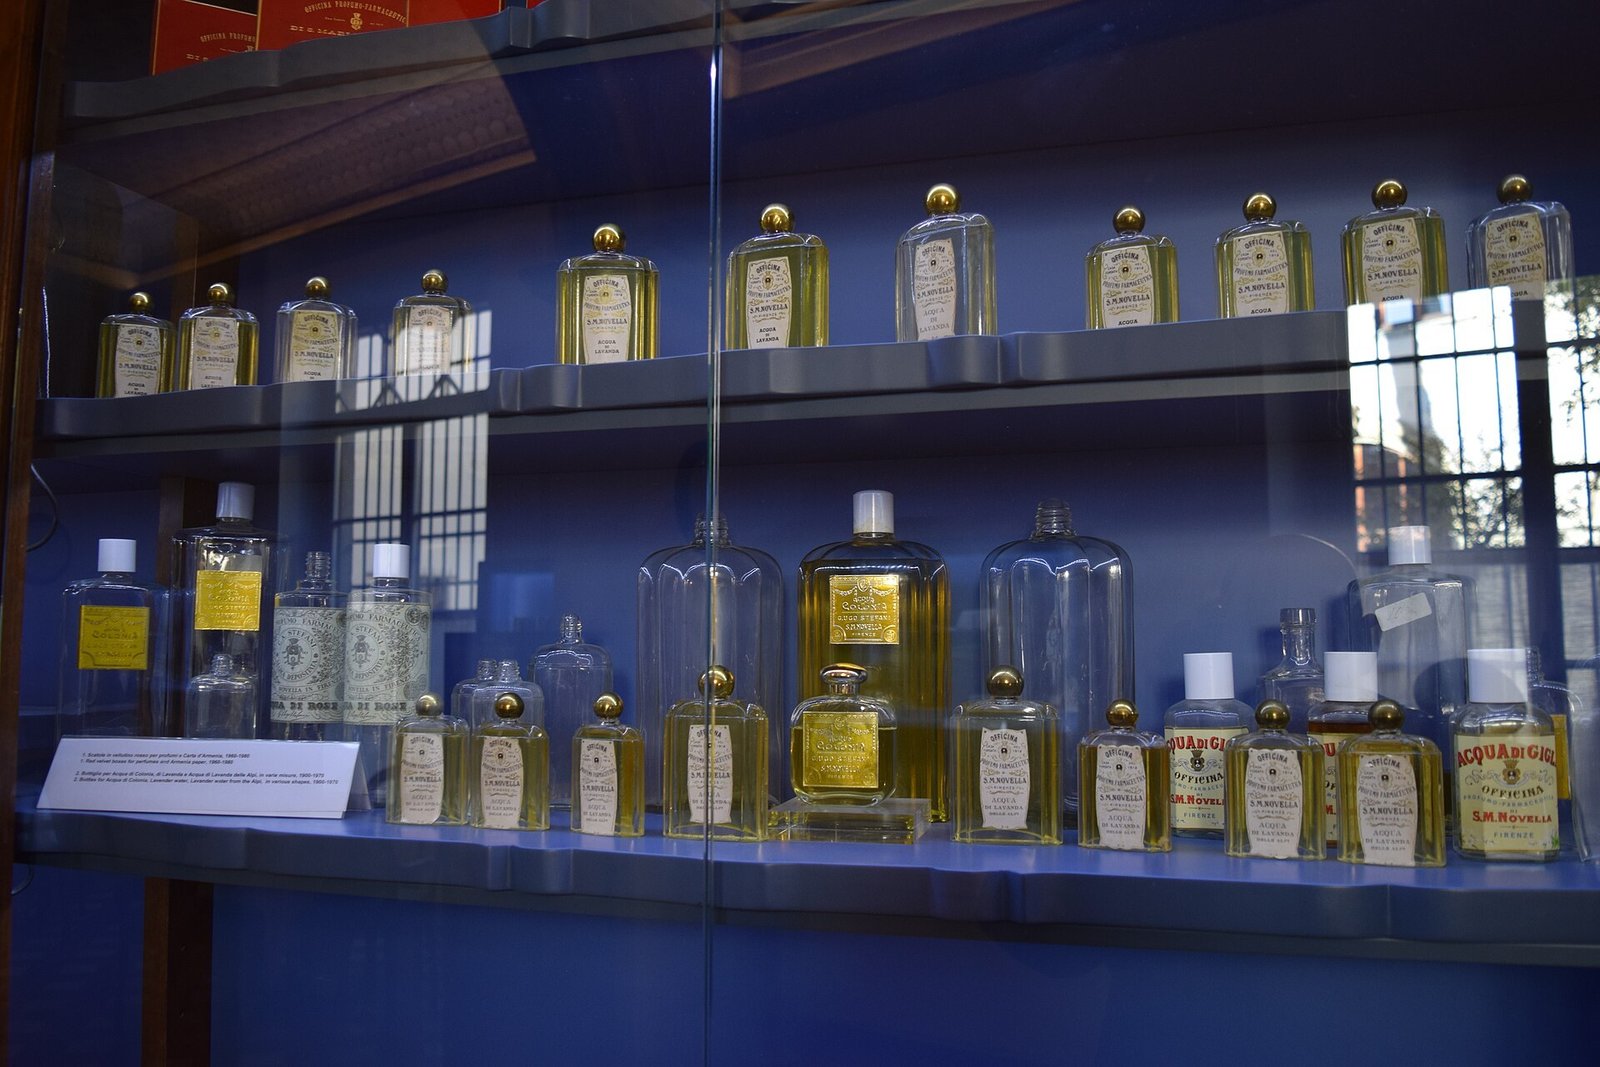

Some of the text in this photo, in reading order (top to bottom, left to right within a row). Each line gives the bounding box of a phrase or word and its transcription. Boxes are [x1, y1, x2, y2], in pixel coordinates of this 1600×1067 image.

[304, 1, 407, 24] OFFICINA PROFUMO-FARMACEUTIC
[200, 32, 226, 43] OFFICINA
[1373, 224, 1405, 236] OFFICINA
[1496, 220, 1529, 232] OFFICINA
[1244, 238, 1274, 249] OFFICINA
[922, 246, 946, 256] OFFICINA
[1111, 252, 1139, 263] OFFICINA
[756, 263, 780, 274] OFFICINA
[593, 278, 619, 288] OFFICINA
[418, 309, 442, 318] OFFICINA
[923, 308, 944, 317] ACQUA
[304, 315, 328, 324] OFFICINA
[127, 329, 152, 338] OFFICINA
[920, 323, 950, 333] LAVANDA
[842, 602, 887, 610] COLONIA
[287, 630, 317, 648] STEFANI
[355, 626, 384, 645] STEFANI
[290, 701, 338, 710] DI ROSE
[357, 701, 407, 710] DI ROSE
[410, 736, 434, 745] OFFICINA
[990, 733, 1018, 743] OFFICINA
[489, 740, 512, 748] OFFICINA
[1105, 749, 1133, 760] OFFICINA
[1257, 753, 1288, 764] OFFICINA
[1458, 743, 1557, 768] ACQUA DI GIGL
[1368, 757, 1400, 769] OFFICINA
[1174, 772, 1224, 784] OFFICINA
[1482, 785, 1544, 799] OFFICINA
